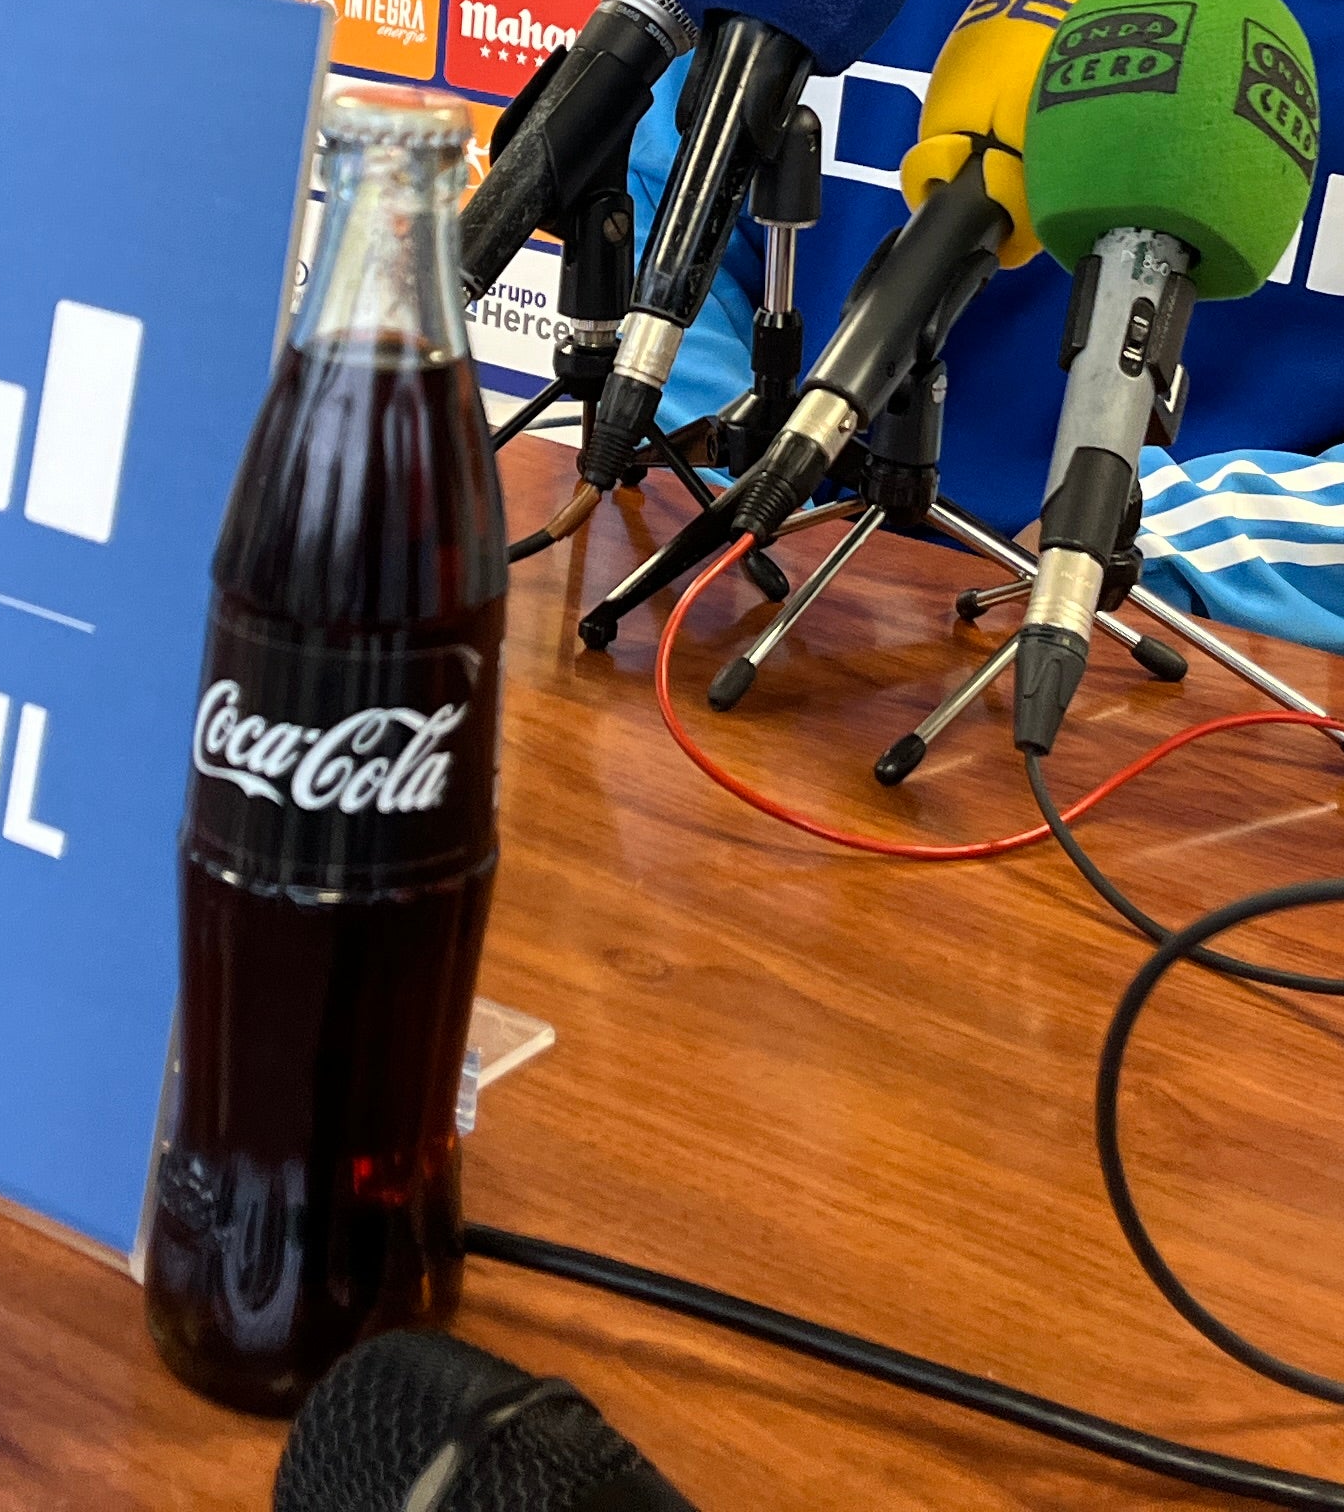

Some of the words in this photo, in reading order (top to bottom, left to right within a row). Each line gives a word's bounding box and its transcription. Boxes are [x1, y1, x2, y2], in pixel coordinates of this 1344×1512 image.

[1066, 21, 1164, 50] ONDA
[1060, 54, 1158, 86] CERO
[193, 678, 469, 814] Coca-Cola
